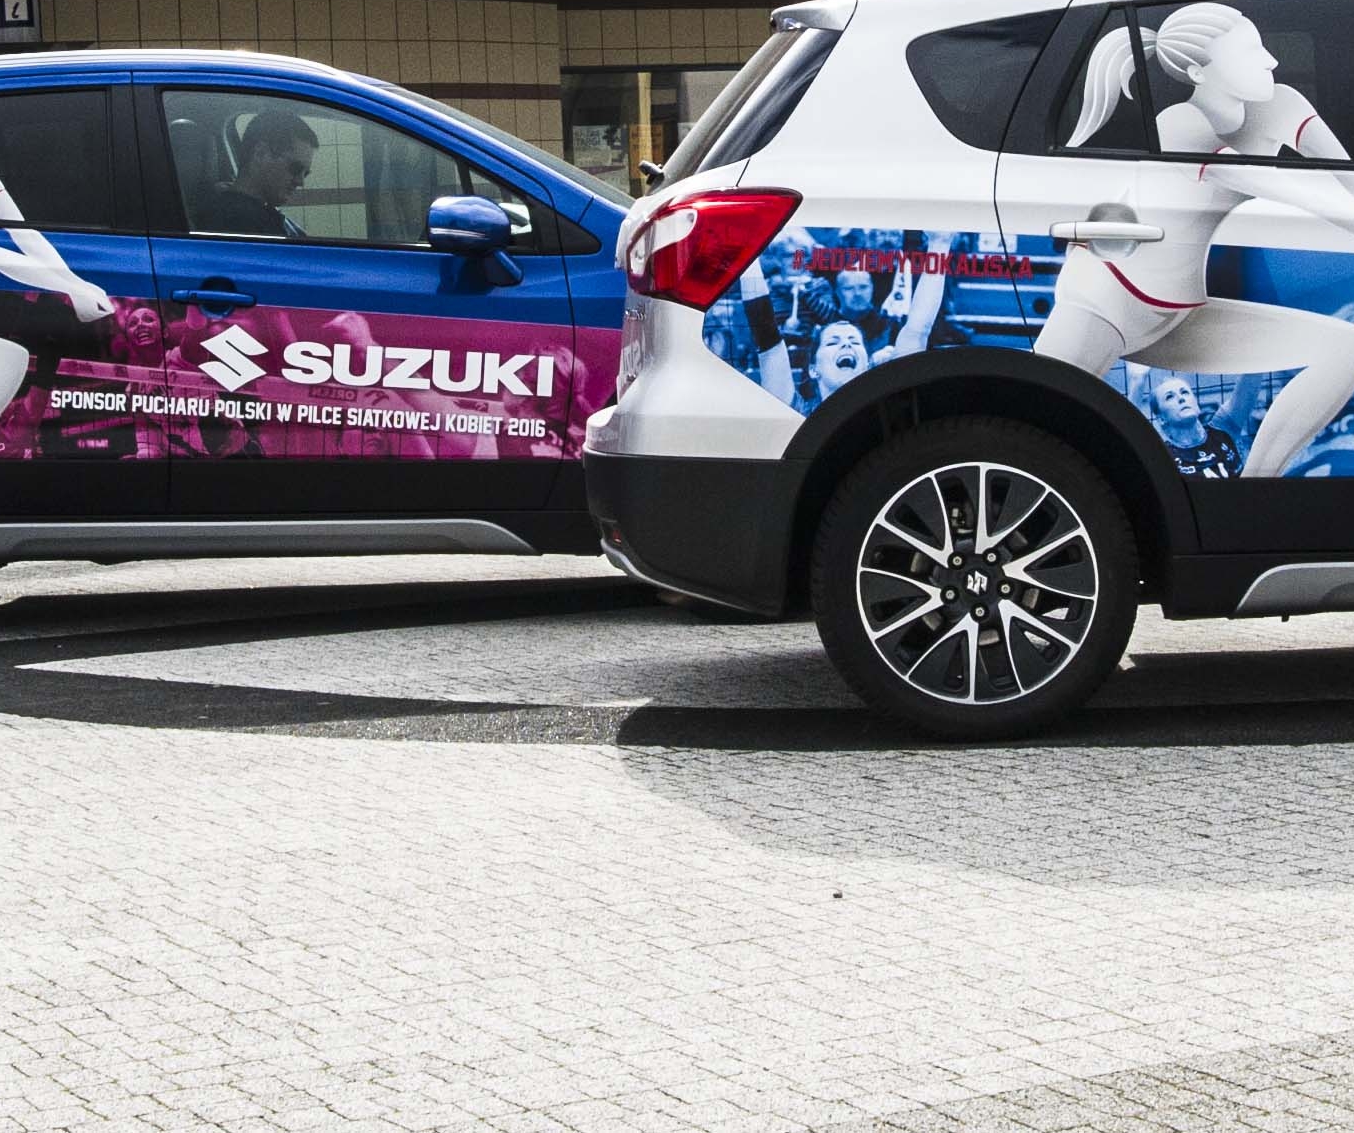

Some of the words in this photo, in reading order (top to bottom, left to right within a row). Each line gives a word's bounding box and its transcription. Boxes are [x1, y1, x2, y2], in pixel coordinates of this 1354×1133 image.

[792, 246, 1034, 281] #JEDZIEMYDOKALISZA
[281, 341, 555, 397] SUZUKI
[51, 390, 127, 412] SPONSOR
[131, 394, 210, 417] PUCHARU
[214, 399, 272, 421] POLSKI
[276, 403, 293, 423] W
[347, 407, 441, 431] SIATKOWEJ
[445, 413, 504, 435] KOBIET
[507, 417, 546, 438] 2016
